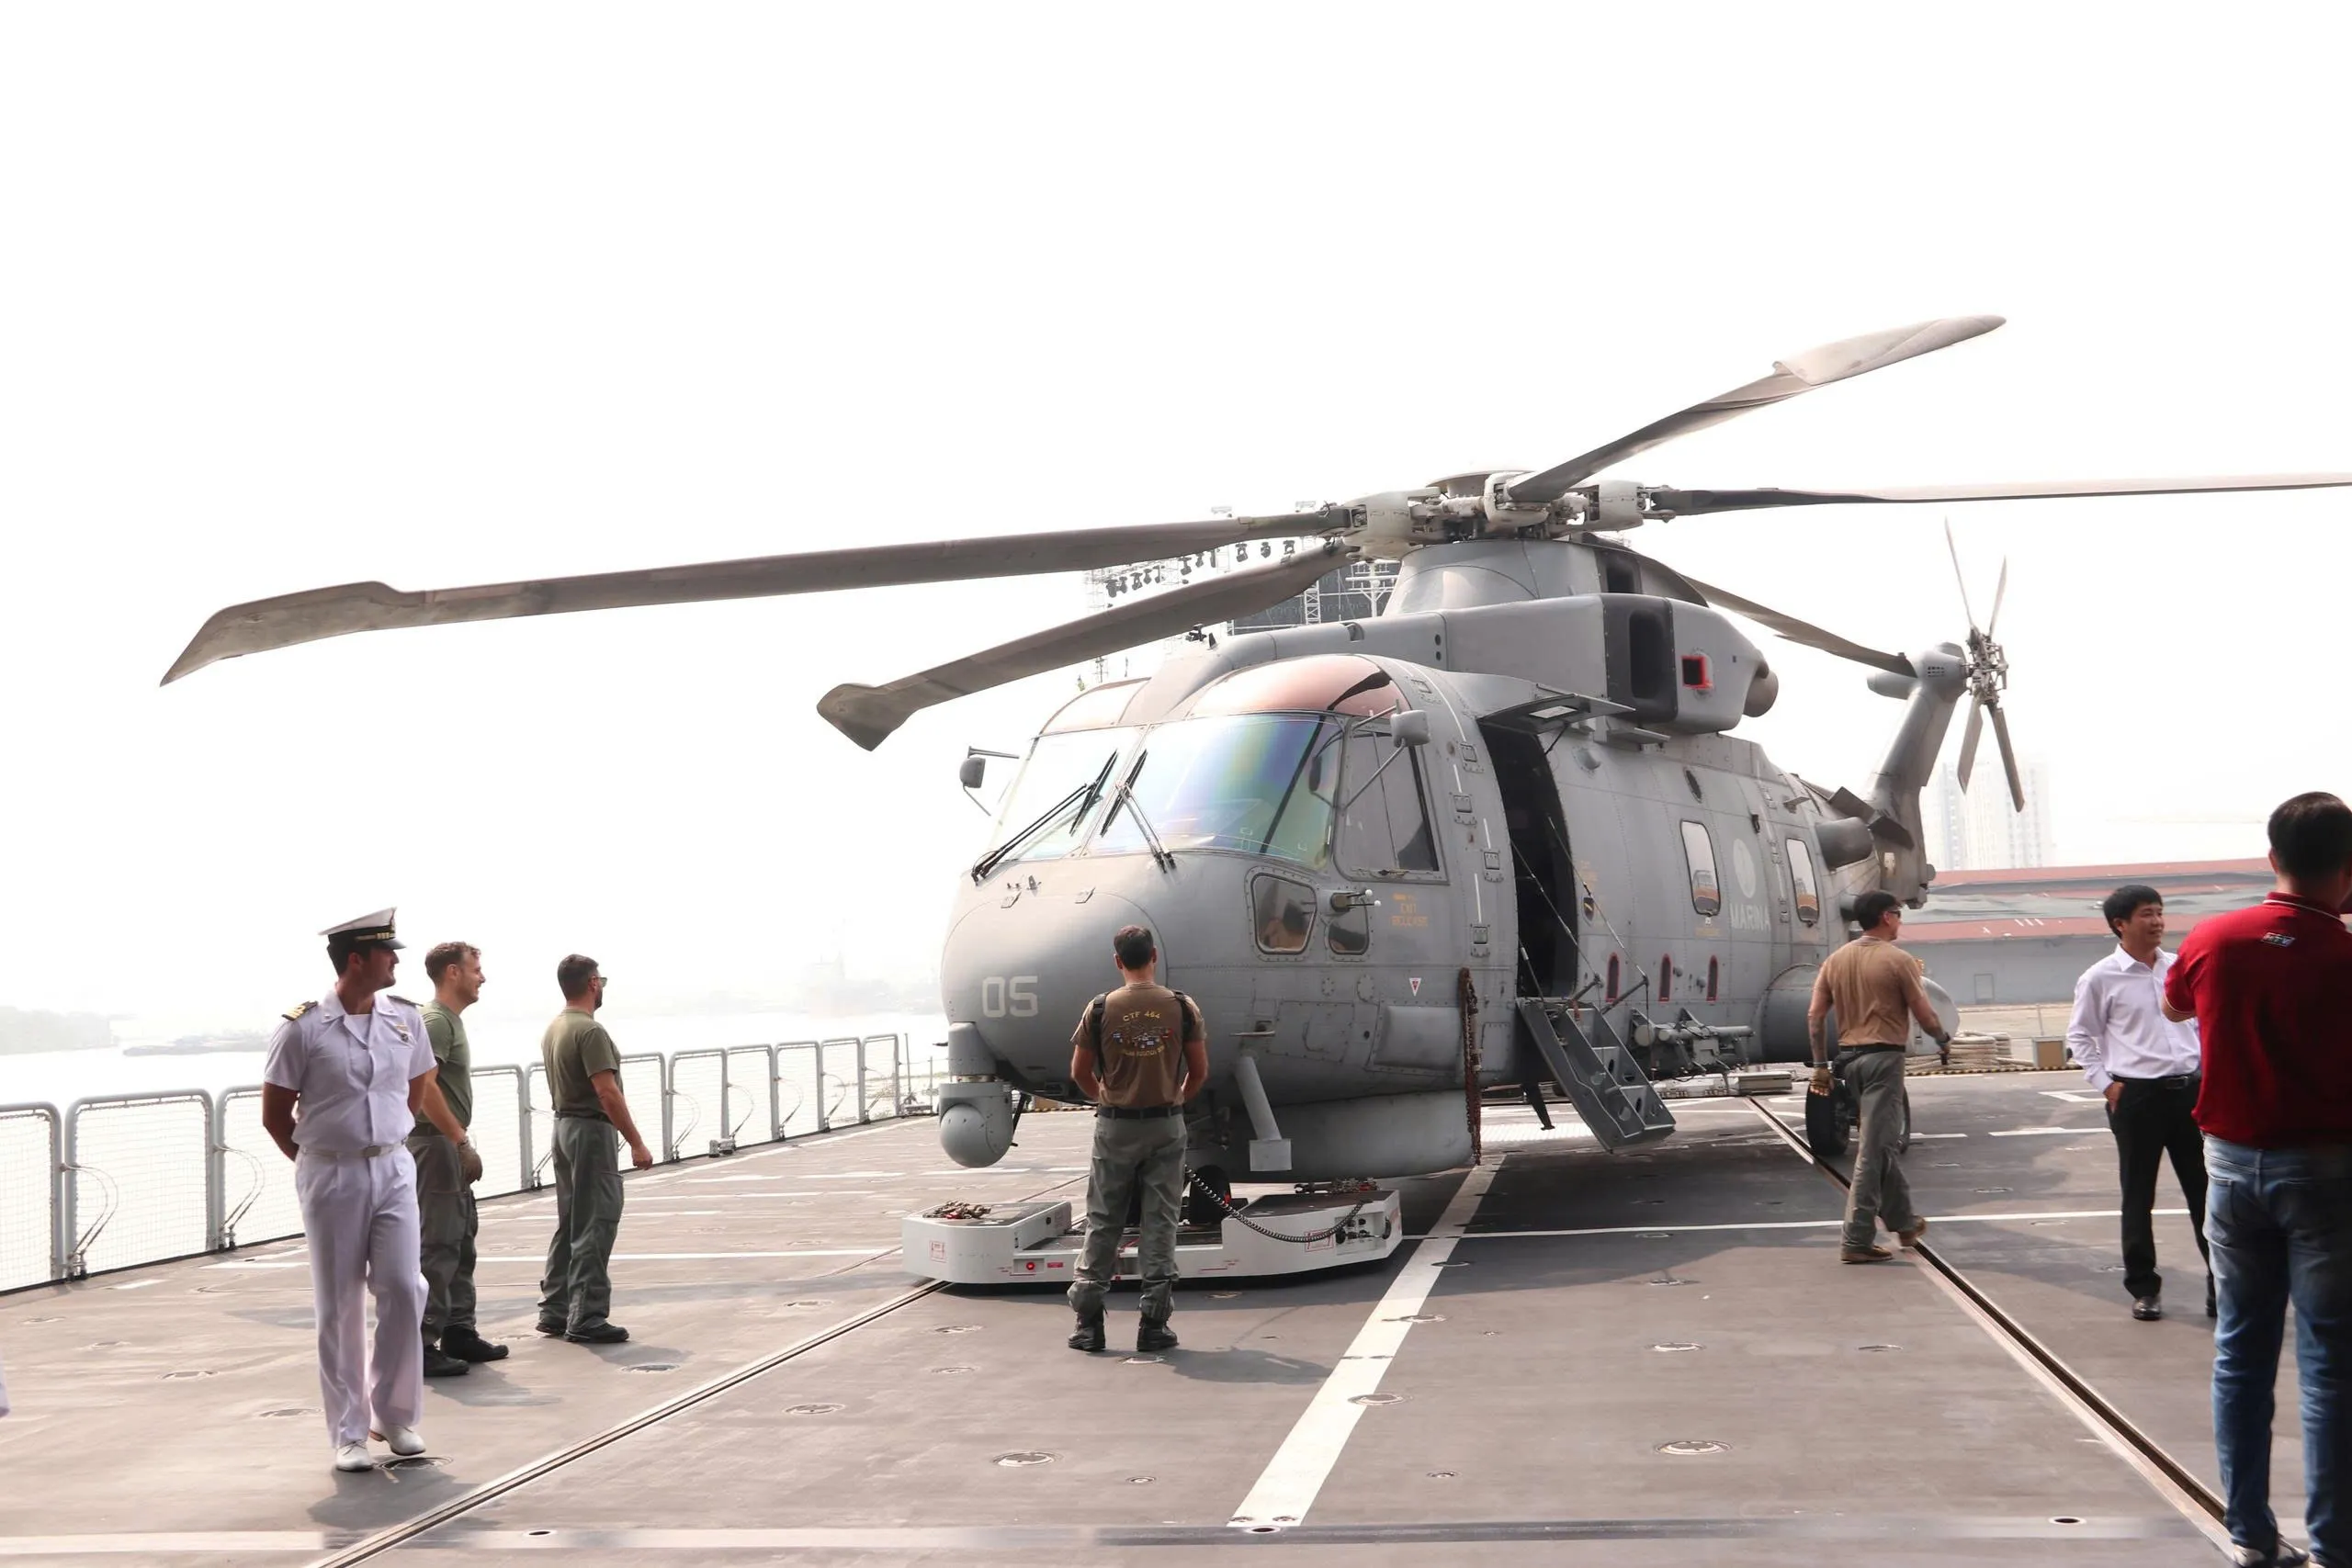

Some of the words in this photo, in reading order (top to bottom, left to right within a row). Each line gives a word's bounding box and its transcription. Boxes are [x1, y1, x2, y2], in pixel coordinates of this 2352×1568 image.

[1729, 903, 1771, 931] MARINA
[982, 976, 1038, 1018] 05
[1123, 1011, 1141, 1021] CTF
